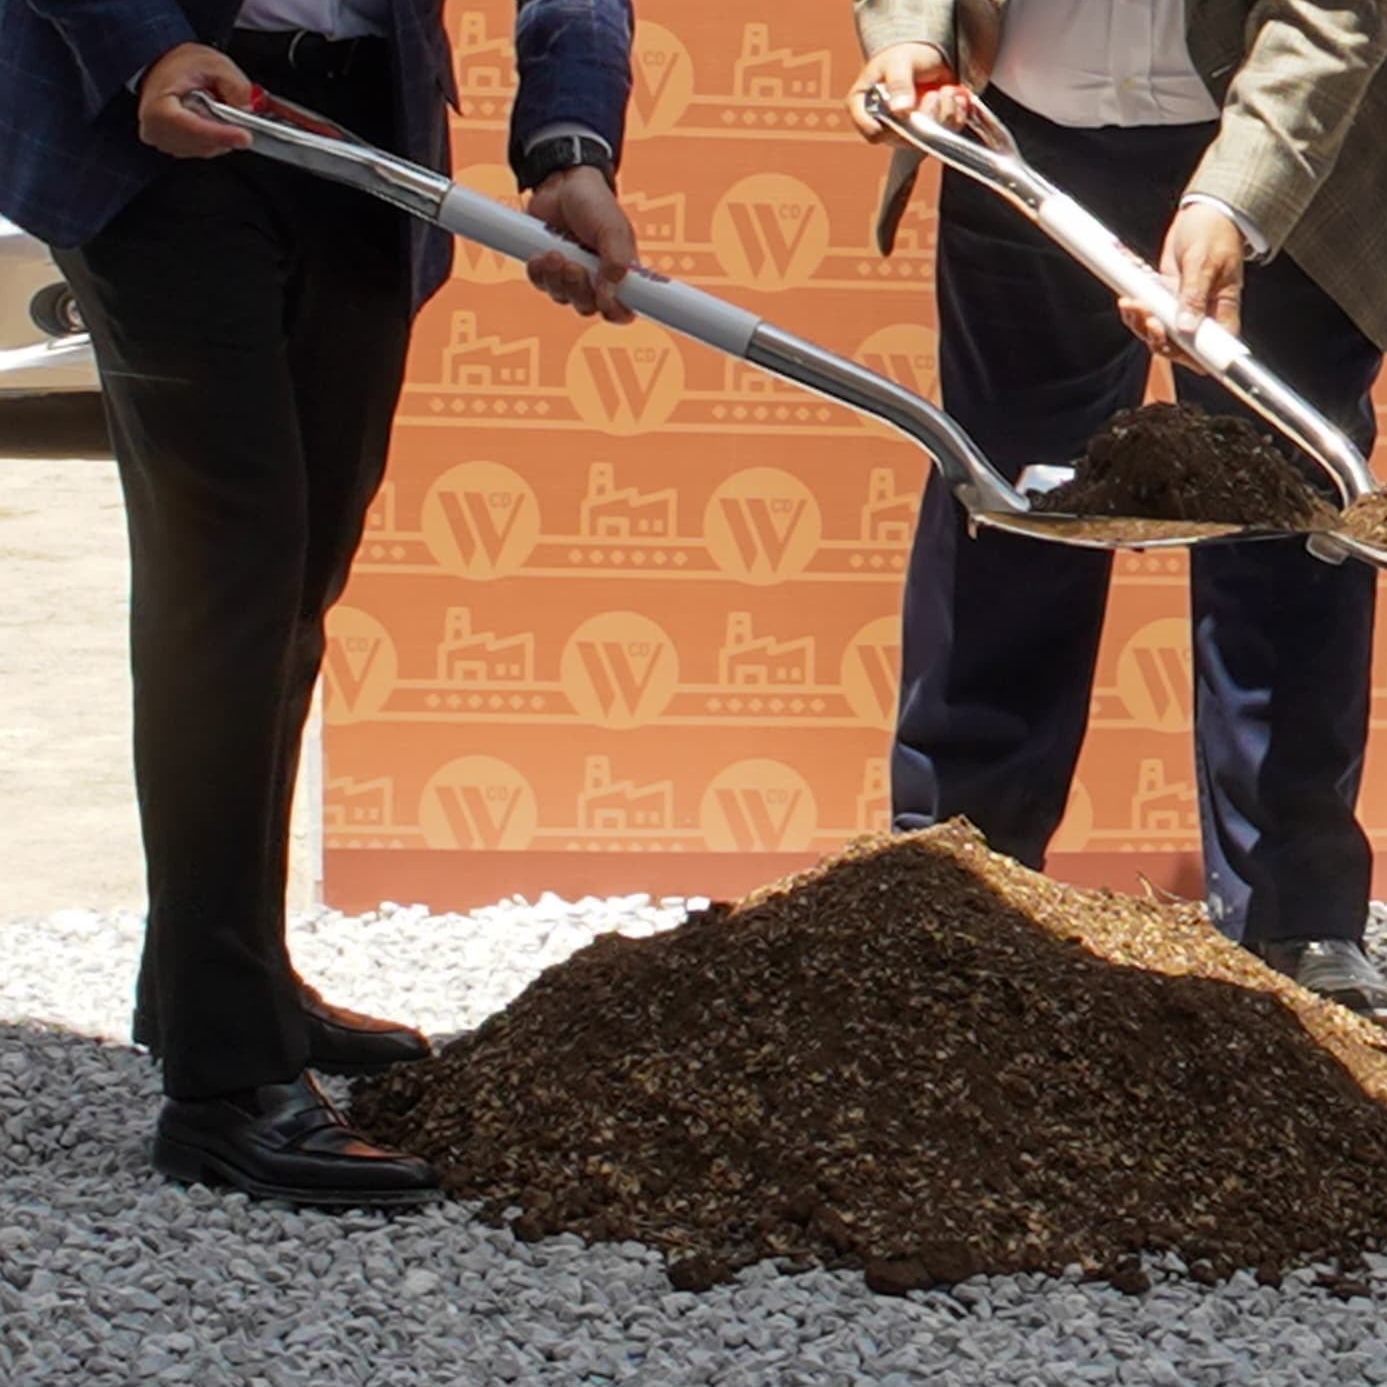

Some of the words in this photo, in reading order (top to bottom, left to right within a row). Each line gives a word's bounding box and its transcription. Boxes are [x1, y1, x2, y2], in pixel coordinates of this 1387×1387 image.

[726, 203, 816, 278] W
[581, 347, 669, 422] W
[438, 492, 525, 566] W
[720, 498, 808, 572] W
[576, 641, 664, 716] W
[436, 786, 521, 849] W
[716, 789, 802, 852] W
